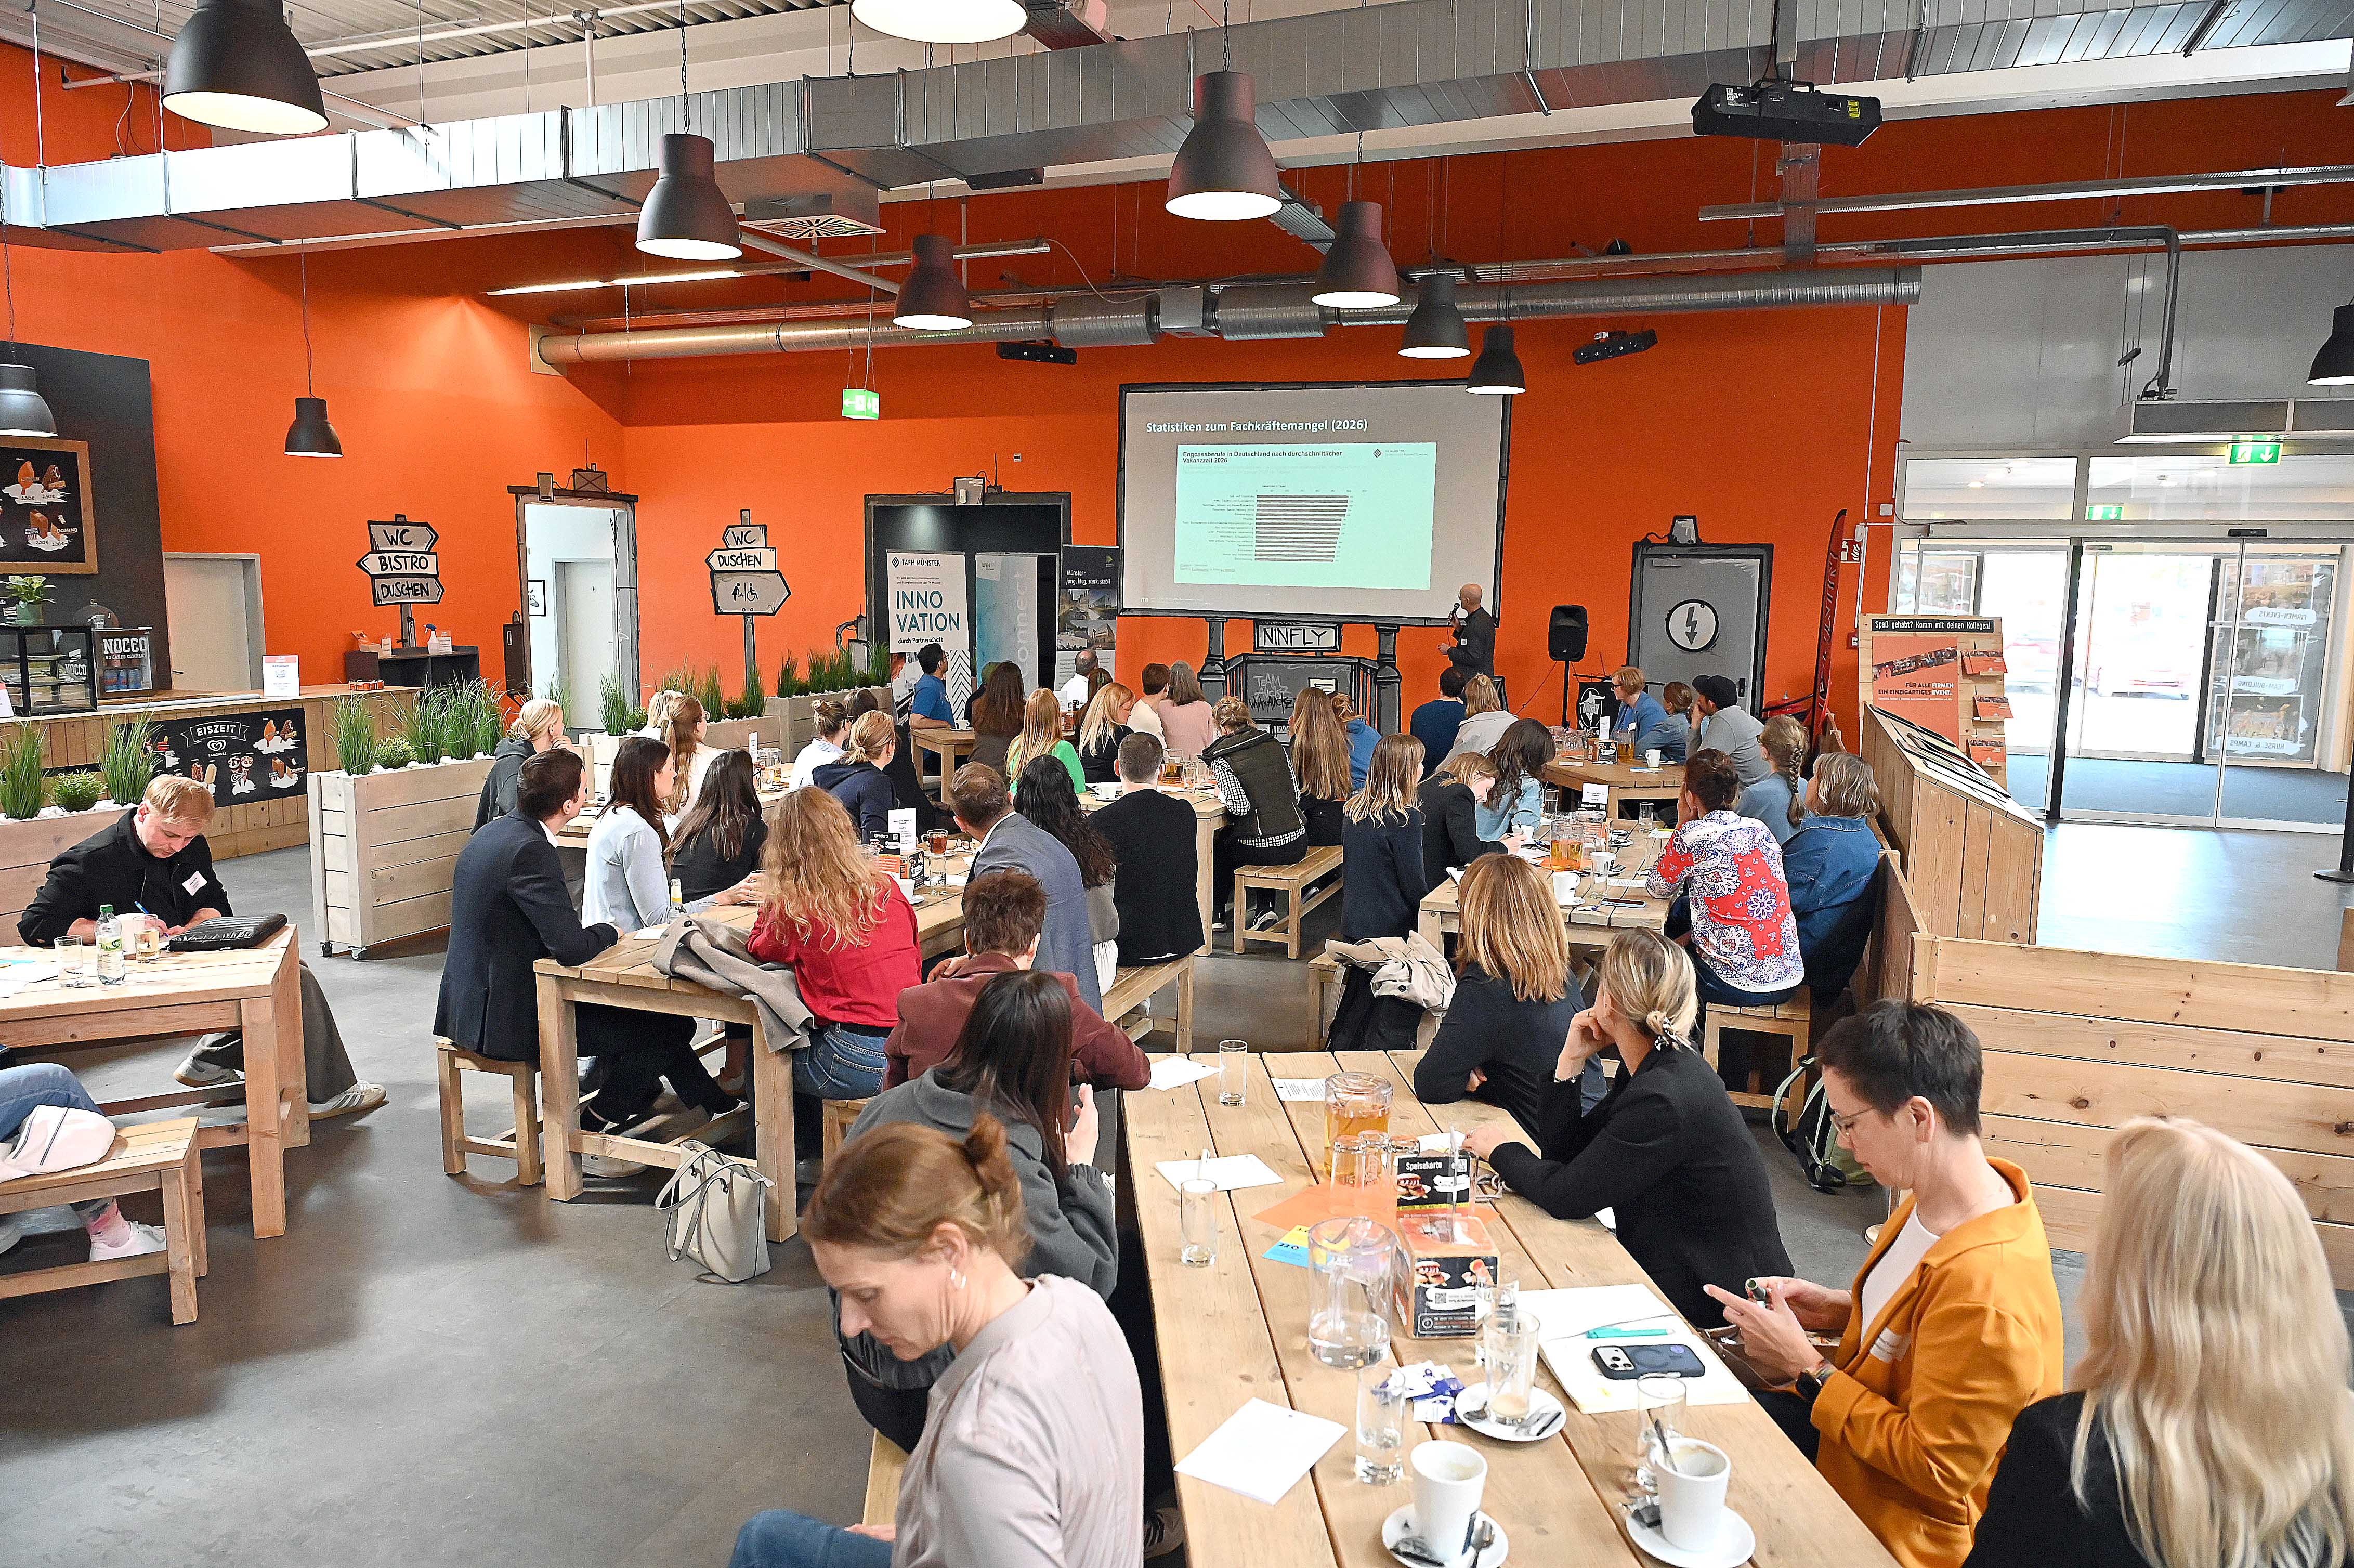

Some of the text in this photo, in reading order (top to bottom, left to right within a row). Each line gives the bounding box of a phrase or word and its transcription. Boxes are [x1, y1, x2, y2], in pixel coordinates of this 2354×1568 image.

[1146, 422, 1201, 433] Statistiken
[1231, 420, 1328, 433] Fachkräftemangel
[1331, 419, 1368, 432] (2026)
[383, 529, 413, 546] WC
[732, 530, 756, 546] WC
[378, 555, 429, 572] BISTRO
[717, 552, 762, 568] DUSCHEN
[380, 581, 429, 598] DUSCHEN
[897, 590, 943, 609] INNO
[896, 612, 960, 632] VATION
[1875, 620, 1889, 629] Spaß
[1891, 621, 1913, 630] gehabt?
[1967, 622, 1991, 630] Kollegen!
[1263, 628, 1327, 646] NINFLY
[102, 637, 146, 654] NOCCO
[64, 663, 87, 676] NOCCO
[1253, 673, 1281, 687] TEAM
[196, 724, 237, 737] EISZEIT
[1405, 1161, 1443, 1172] Speisekarte
